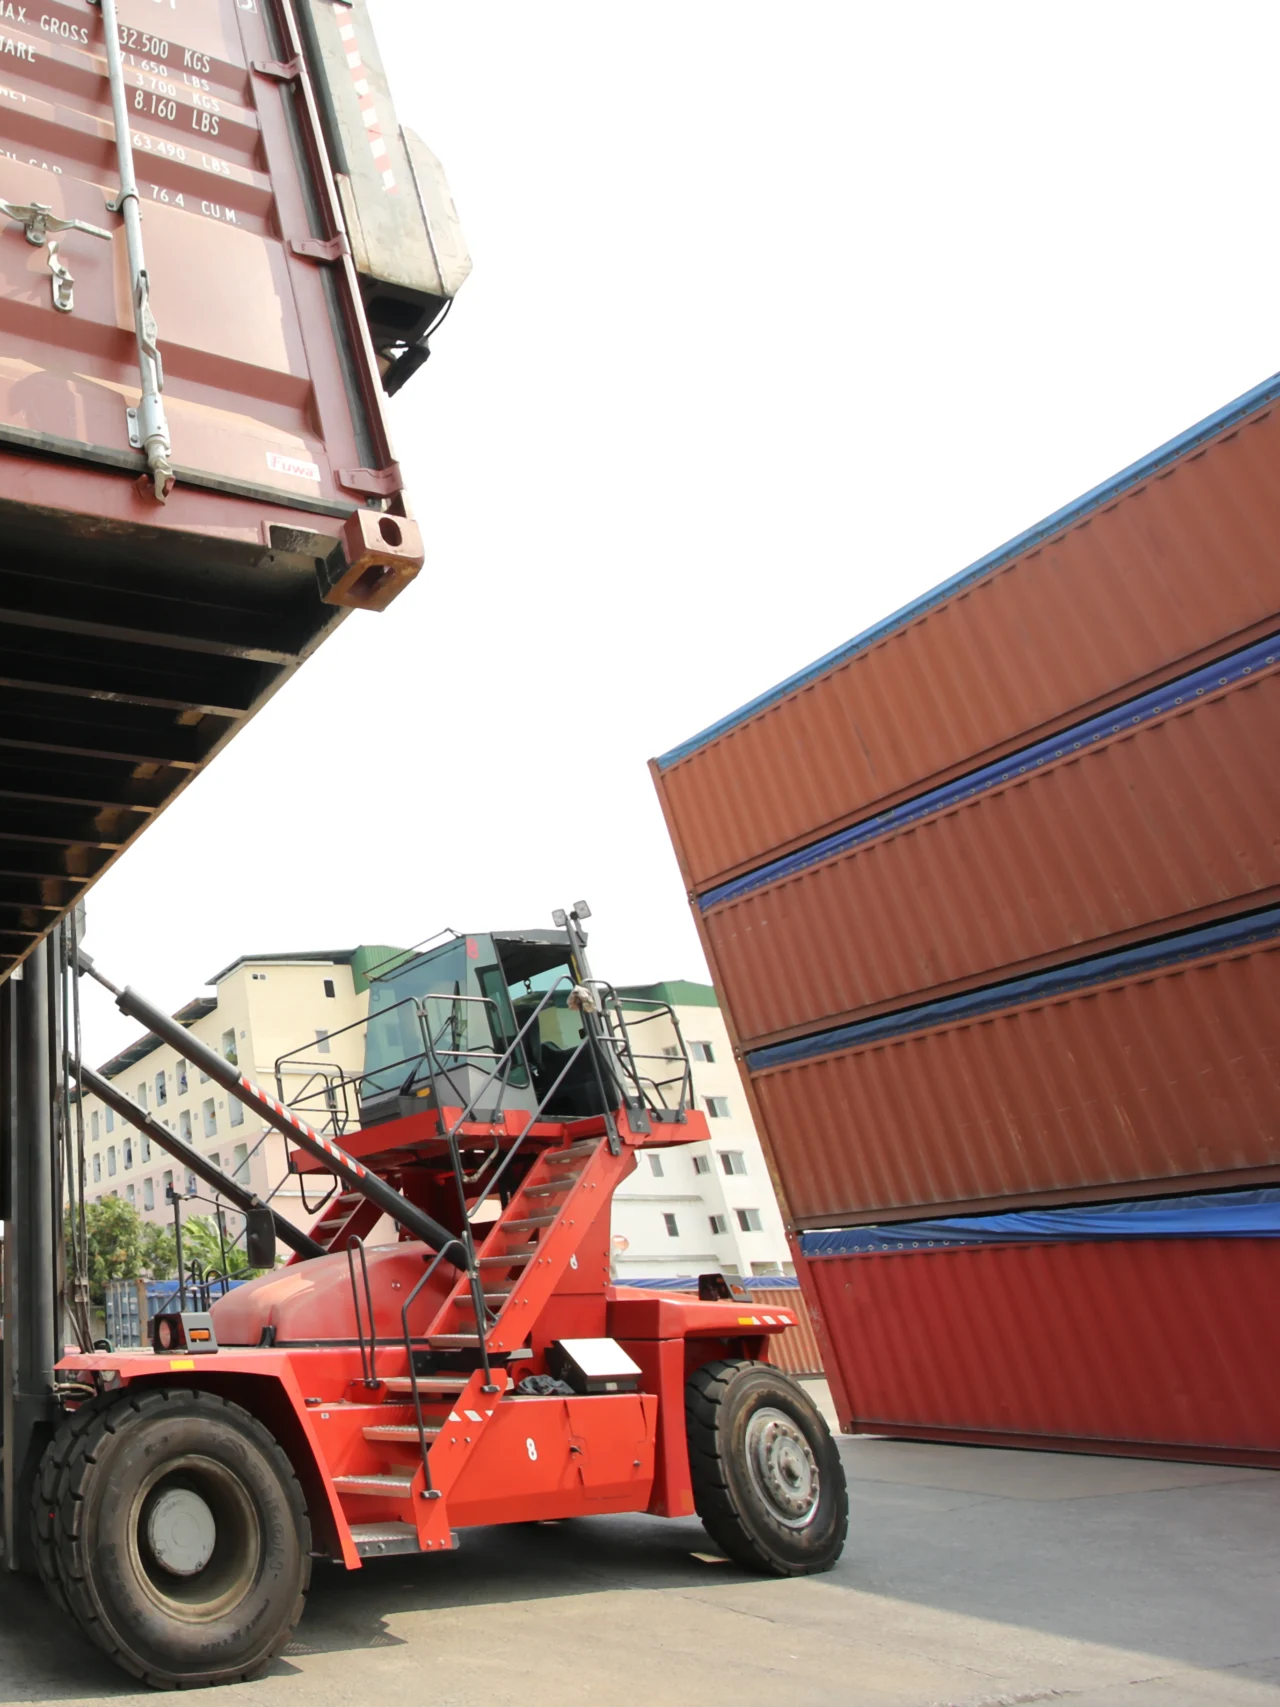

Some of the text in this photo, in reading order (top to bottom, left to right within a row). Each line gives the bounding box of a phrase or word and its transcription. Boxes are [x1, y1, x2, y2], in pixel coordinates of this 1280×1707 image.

[40, 15, 89, 44] GROSS
[119, 26, 169, 59] 32.500
[184, 49, 211, 74] KGS
[120, 50, 210, 92] 71650 LBS
[136, 72, 177, 97] 3.700
[192, 91, 221, 112] KGS
[134, 90, 220, 135] 8.160 LBS
[133, 133, 231, 175] 63.490 LBS
[150, 184, 185, 207] 76.4
[526, 1437, 538, 1461] 8
